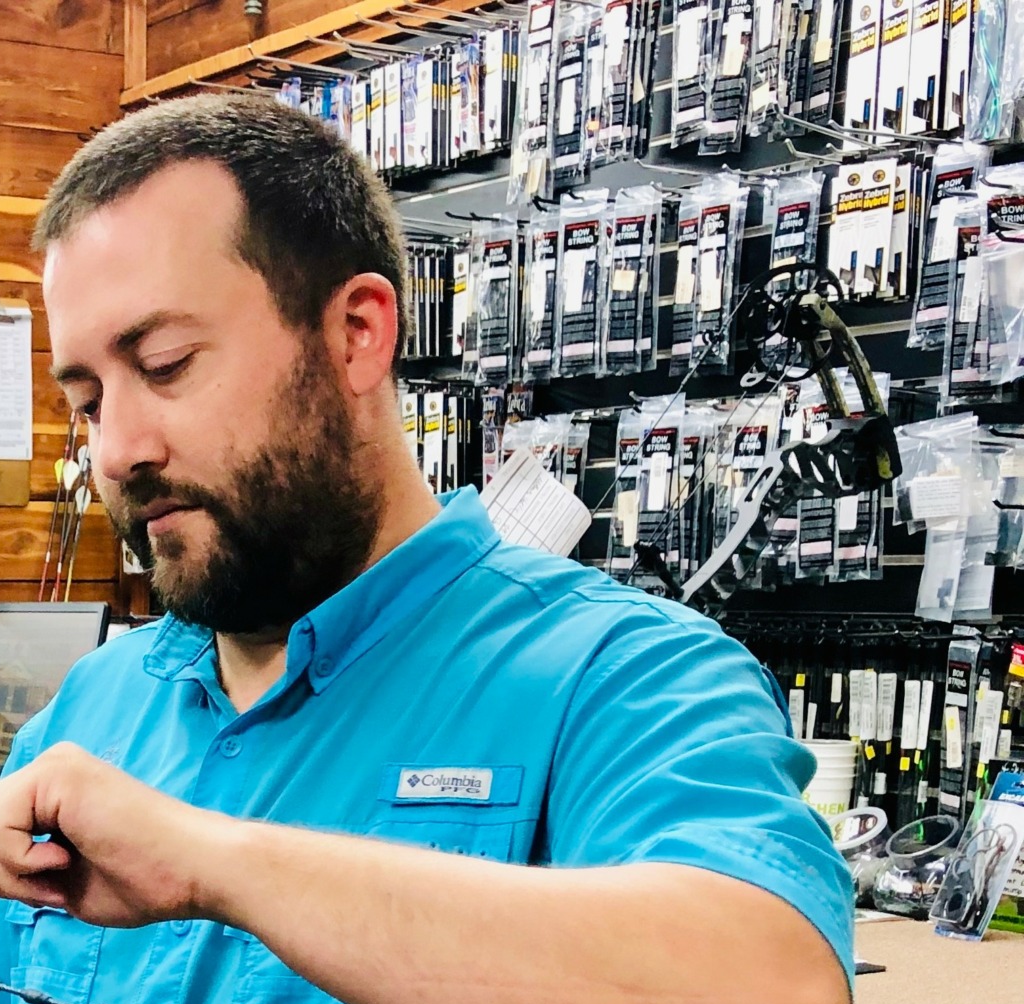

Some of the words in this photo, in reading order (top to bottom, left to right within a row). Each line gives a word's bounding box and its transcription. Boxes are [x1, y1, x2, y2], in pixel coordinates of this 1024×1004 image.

[864, 187, 889, 199] Zebra
[863, 195, 889, 209] Hybrid
[784, 210, 800, 221] BOW
[621, 223, 638, 233] BOW
[780, 218, 804, 230] STRING
[572, 228, 591, 237] BOW
[617, 230, 640, 241] STRING
[568, 235, 594, 246] STRING
[651, 435, 669, 444] BOW
[646, 442, 671, 452] STRING
[421, 774, 482, 788] Columbia
[440, 786, 481, 794] PFG
